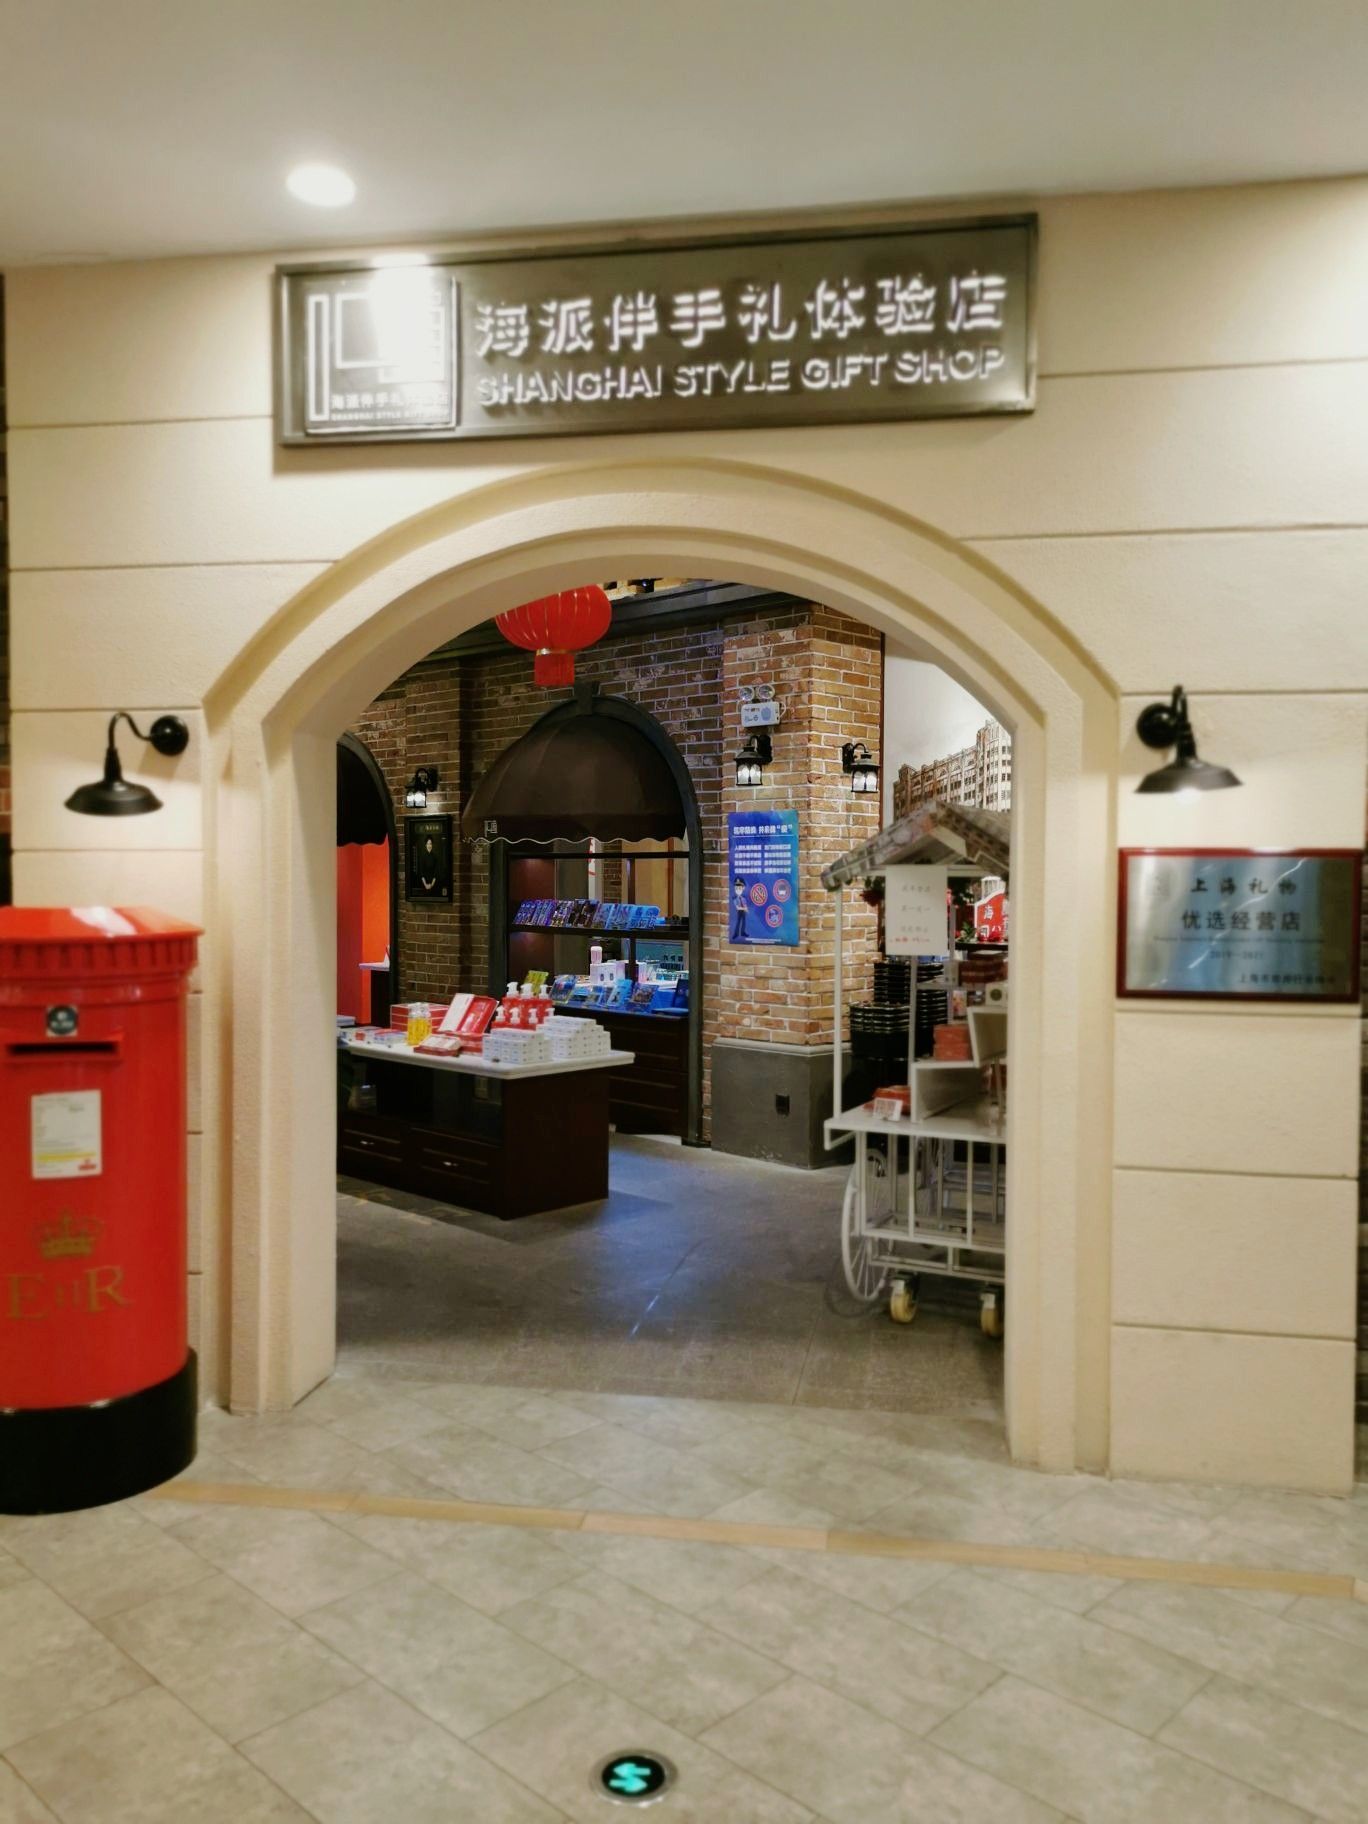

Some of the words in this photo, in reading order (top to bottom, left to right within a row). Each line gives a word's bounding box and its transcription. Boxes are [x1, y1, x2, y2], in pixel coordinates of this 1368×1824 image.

[475, 272, 1006, 357] 海派伴手礼体验店
[478, 363, 662, 407] SHANGHAI
[674, 358, 790, 397] STYLE
[801, 352, 889, 389] GIFT
[895, 347, 1004, 383] SHOP
[1181, 910, 1301, 932] 优选经营店
